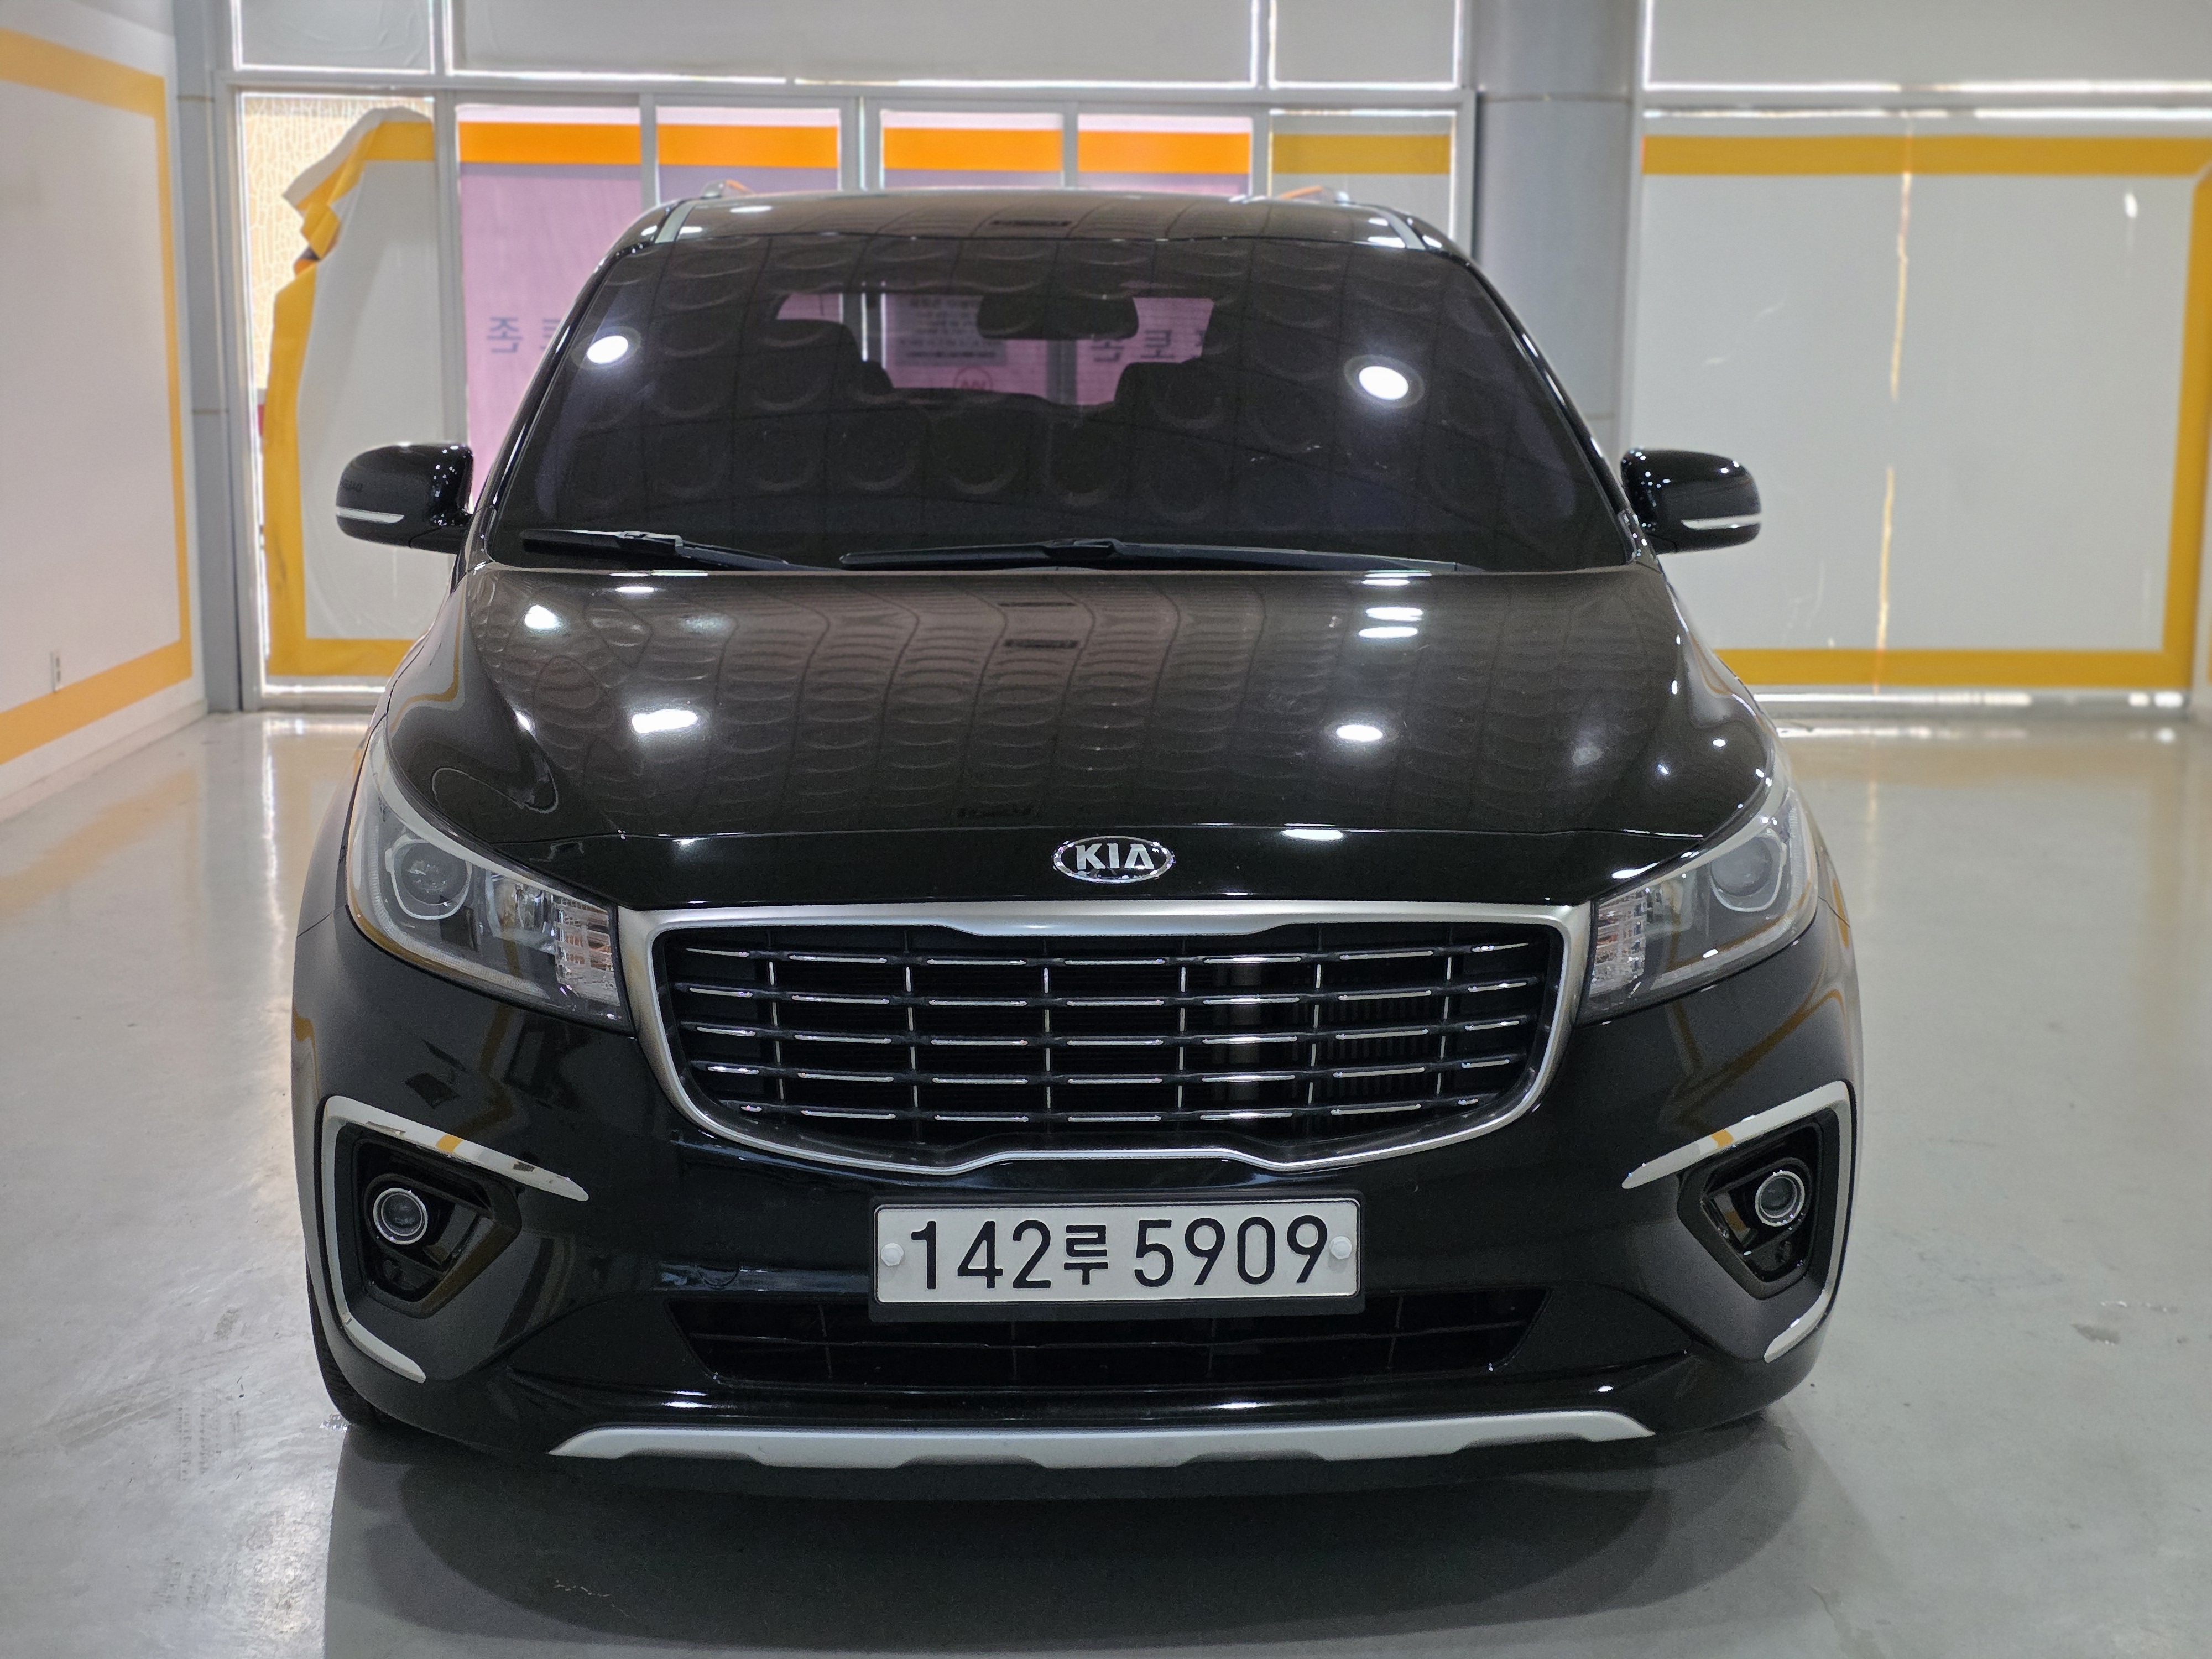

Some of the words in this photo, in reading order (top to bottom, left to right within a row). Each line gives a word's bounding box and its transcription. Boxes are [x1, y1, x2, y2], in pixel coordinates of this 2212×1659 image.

[1076, 843, 1155, 870] KIA
[911, 1220, 1108, 1289] 142루
[1134, 1215, 1328, 1287] 5909
